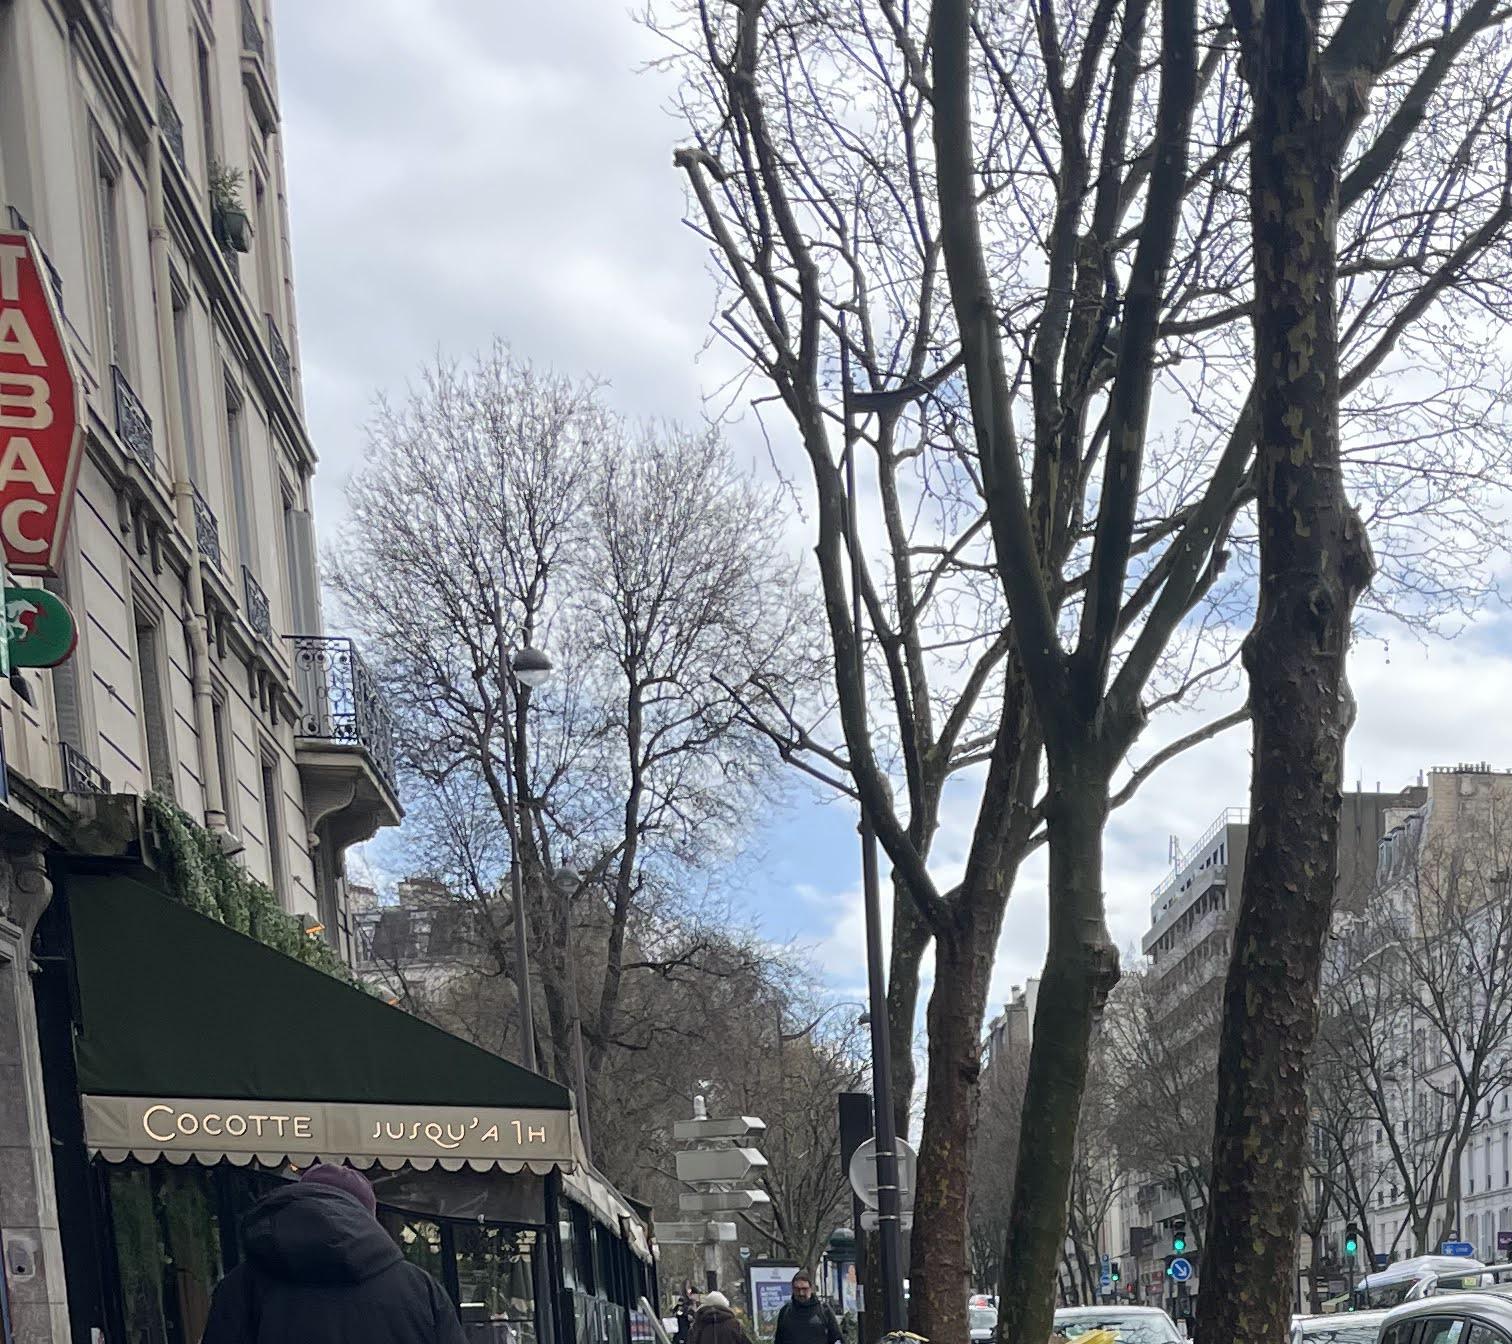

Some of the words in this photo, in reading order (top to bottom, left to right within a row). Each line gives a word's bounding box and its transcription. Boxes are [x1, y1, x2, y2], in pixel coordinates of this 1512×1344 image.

[0, 245, 54, 554] TABAC
[143, 1104, 312, 1141] COCOTTE
[372, 1117, 499, 1148] JUSQU'A
